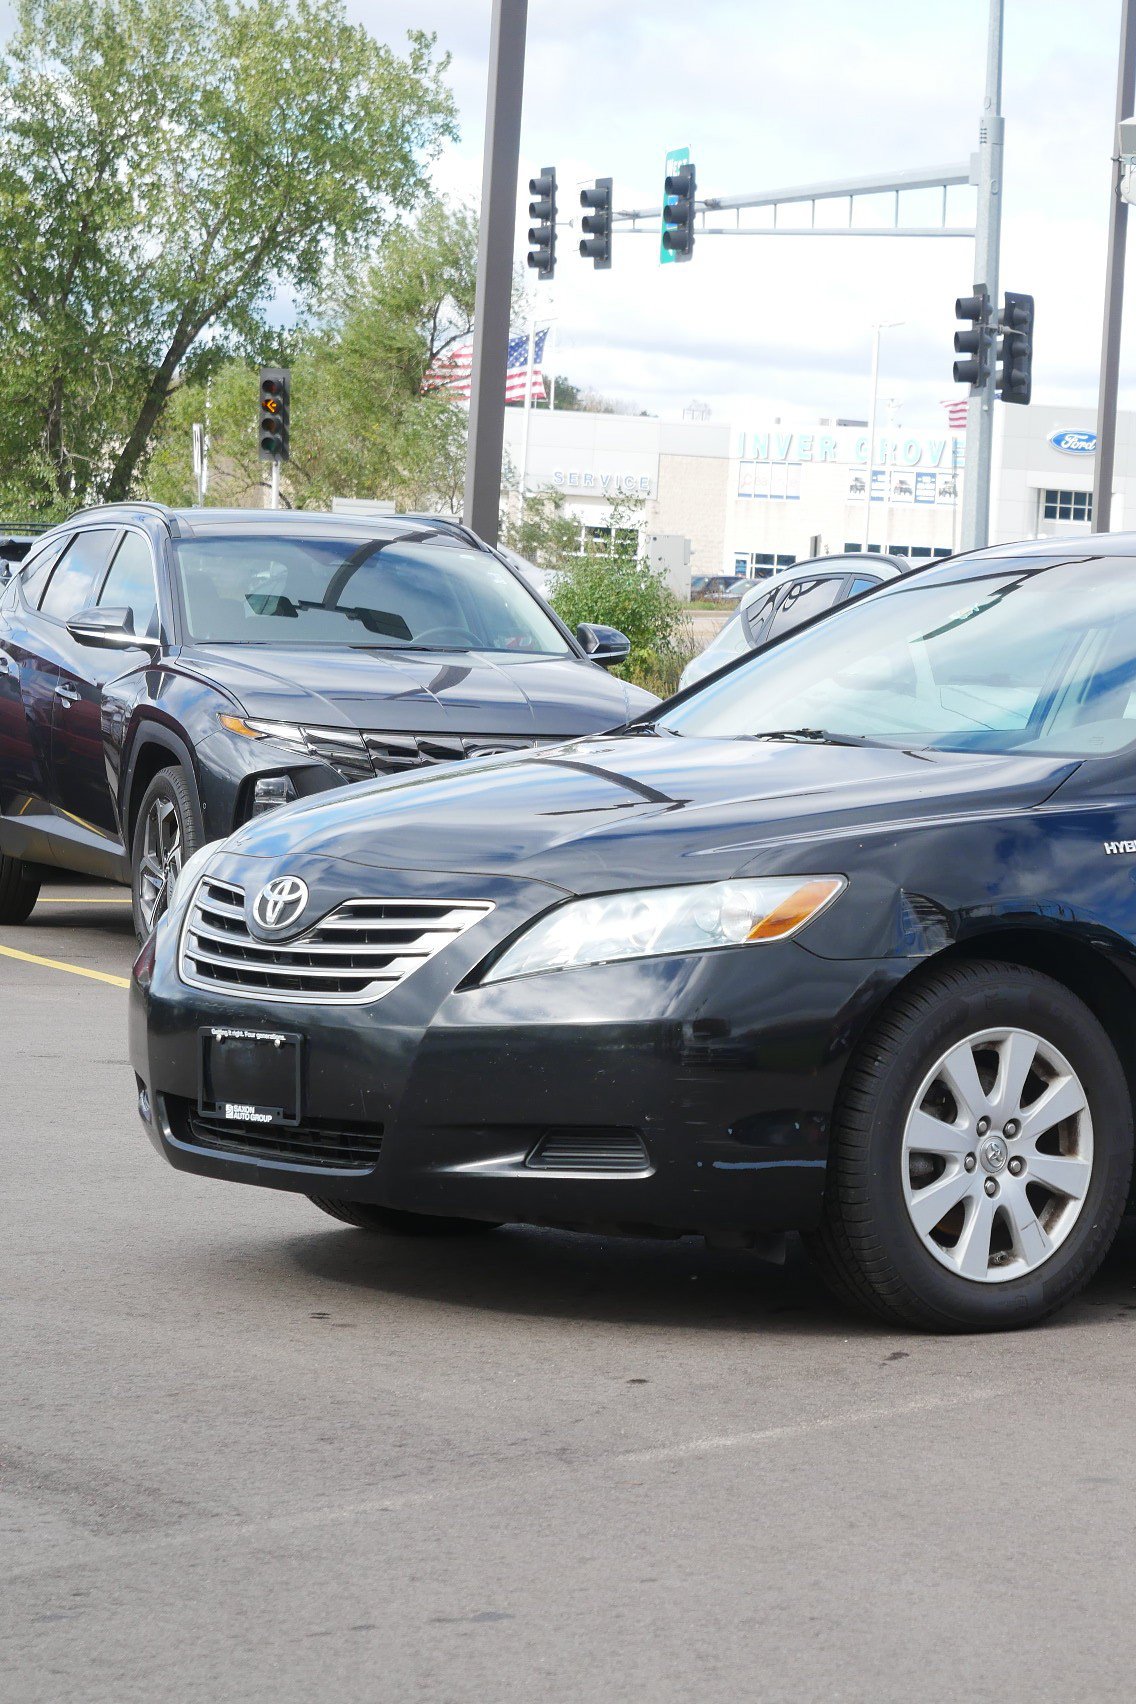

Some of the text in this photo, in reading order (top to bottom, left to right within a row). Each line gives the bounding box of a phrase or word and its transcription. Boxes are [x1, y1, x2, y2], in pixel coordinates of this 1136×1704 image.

[667, 158, 688, 176] WES
[737, 432, 966, 468] INVER GROVE
[1061, 434, 1097, 450] Ford
[553, 471, 650, 490] SERVICE
[234, 1112, 273, 1123] AUTO GROUP
